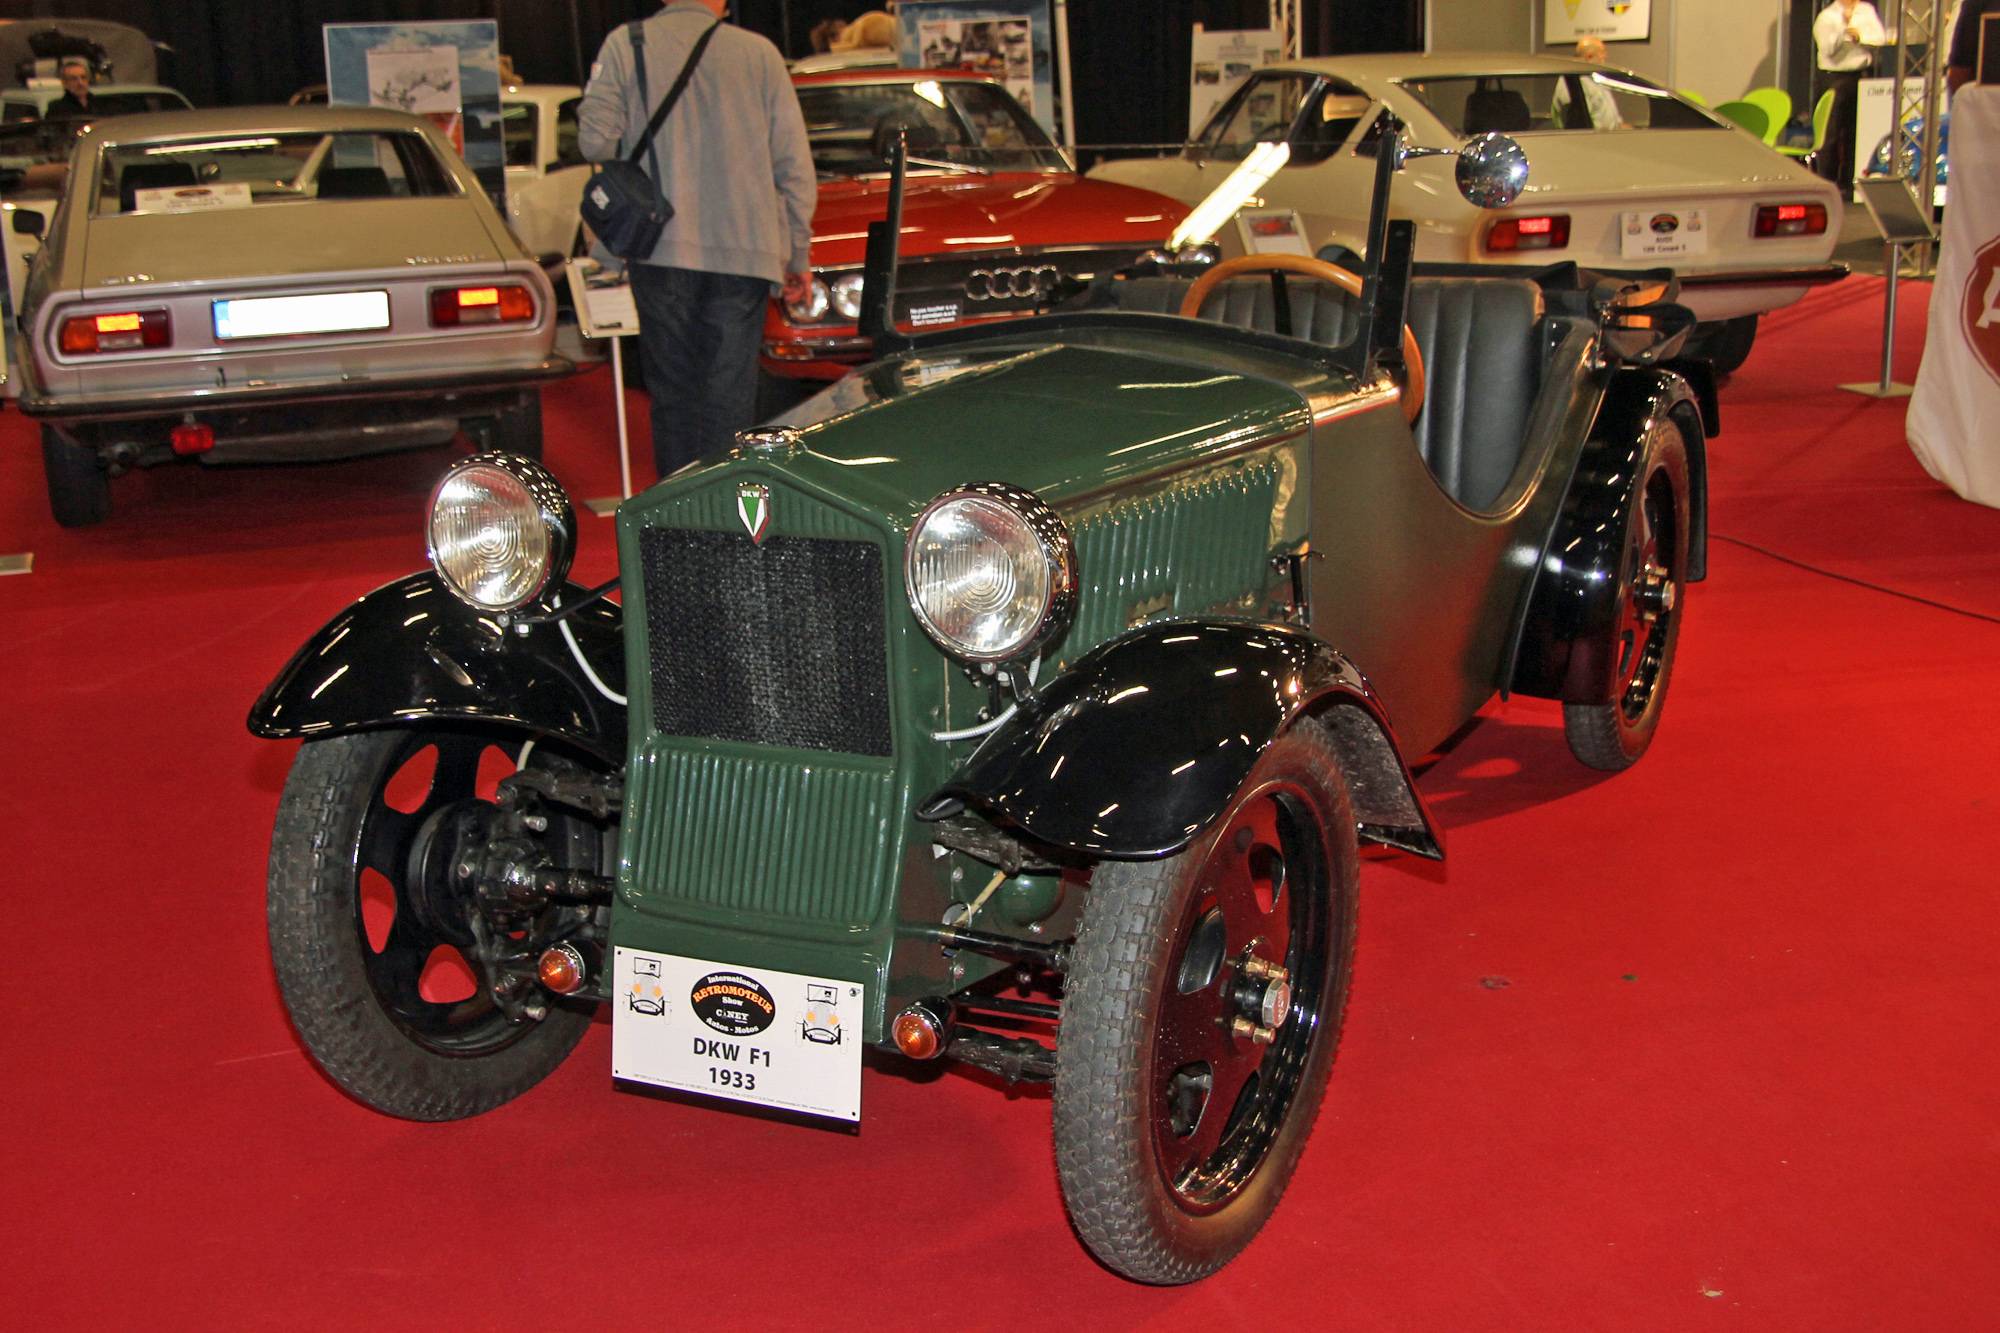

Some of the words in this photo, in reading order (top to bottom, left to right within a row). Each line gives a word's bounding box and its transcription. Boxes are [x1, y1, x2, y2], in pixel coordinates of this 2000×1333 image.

[741, 490, 760, 498] DKW
[706, 975, 760, 992] International
[692, 984, 774, 1015] RETROMOTEUR
[722, 996, 744, 1007] Show
[706, 1017, 729, 1032] Autos
[734, 1025, 759, 1035] Motos
[693, 1037, 741, 1062] DKW
[749, 1047, 770, 1068] F1
[709, 1066, 756, 1091] 1933
